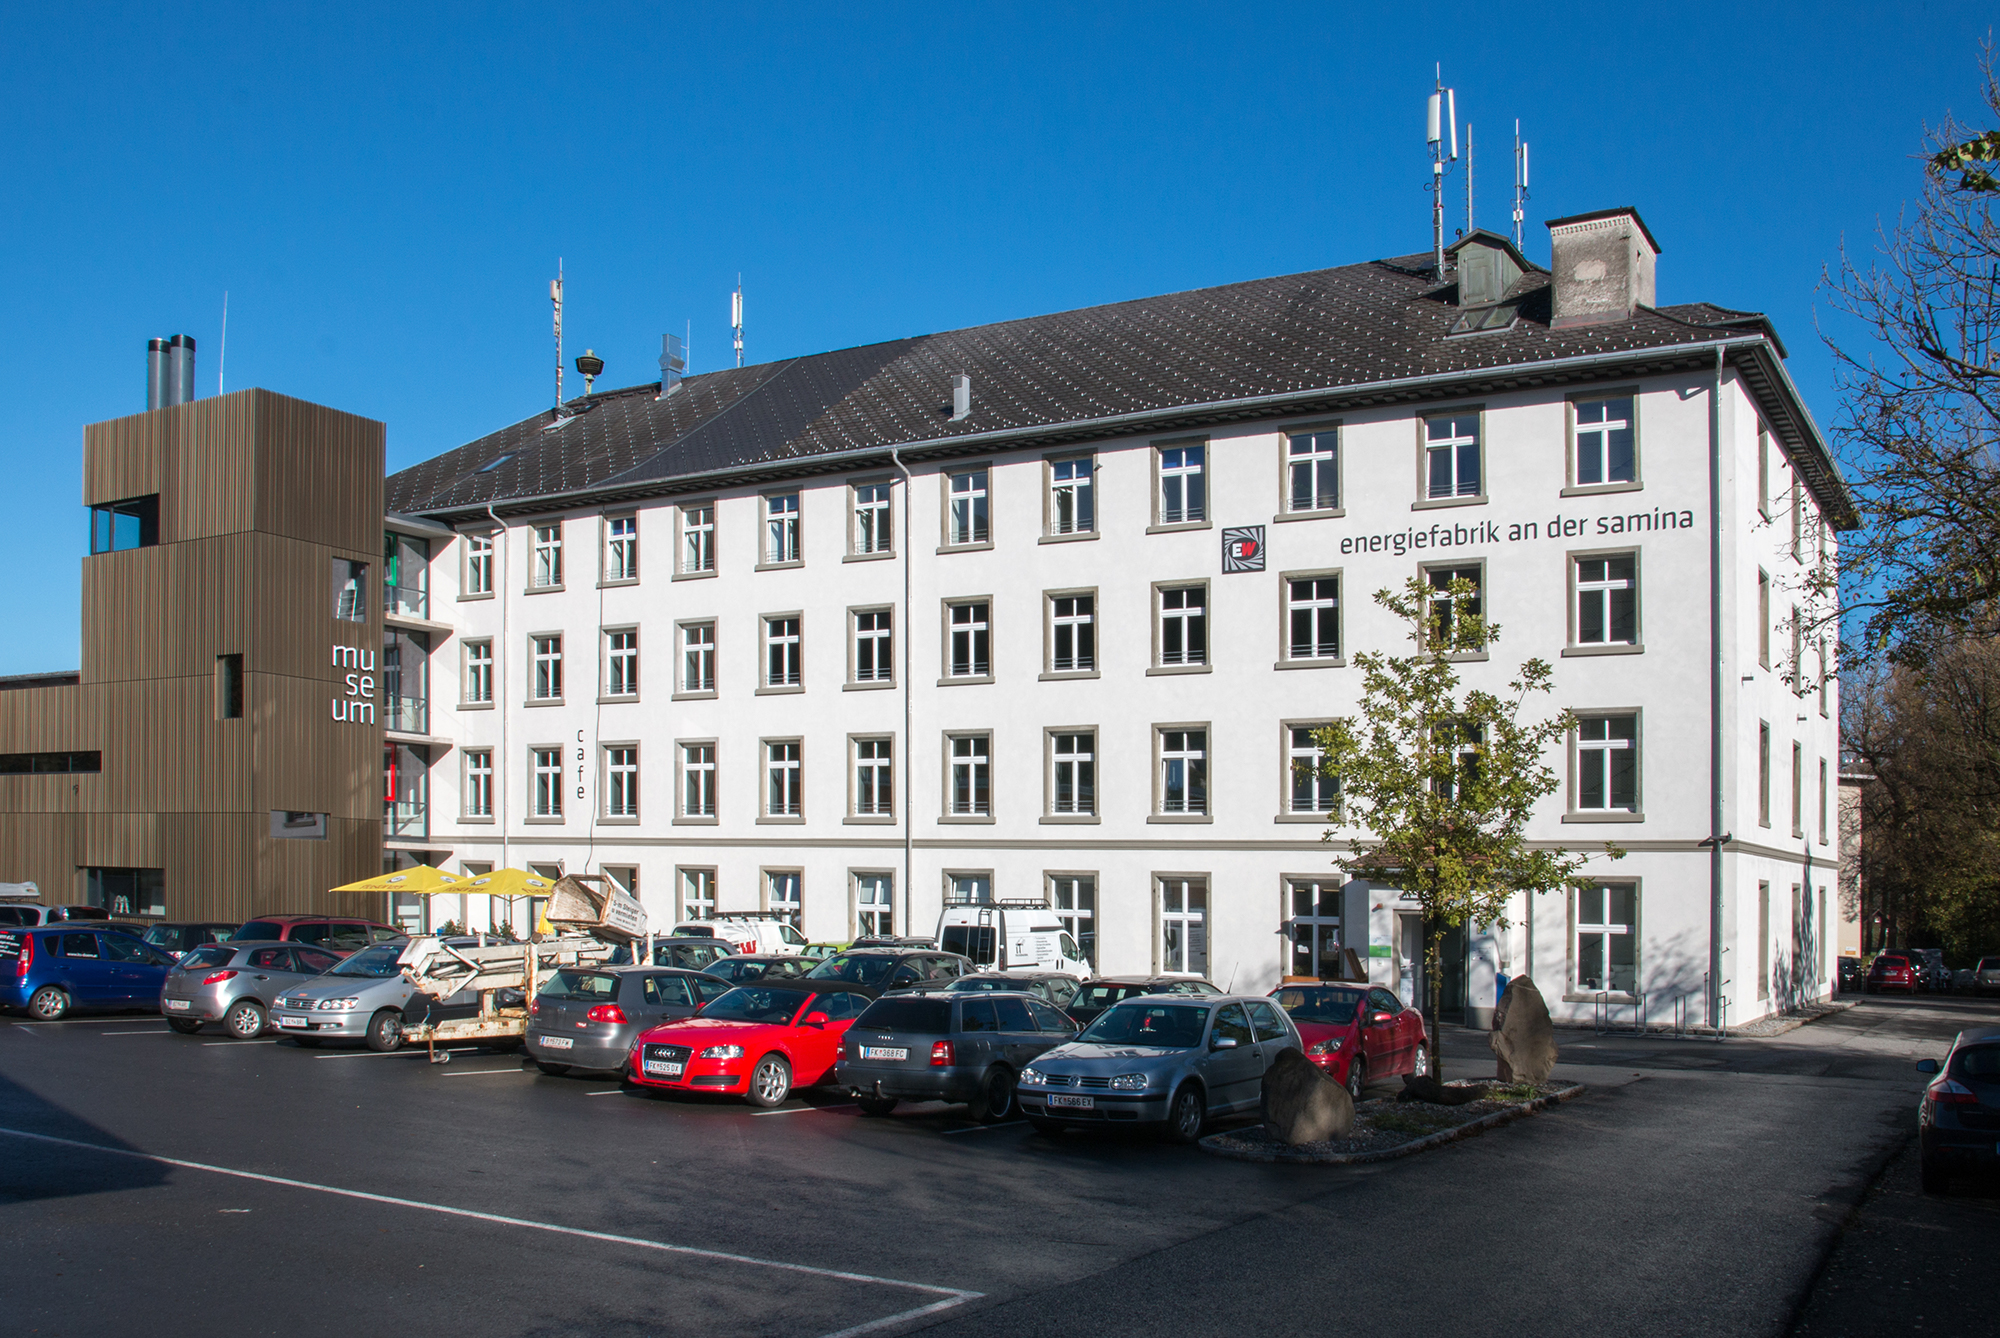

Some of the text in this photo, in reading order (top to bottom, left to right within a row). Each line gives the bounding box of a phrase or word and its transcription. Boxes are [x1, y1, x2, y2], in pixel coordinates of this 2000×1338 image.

[1340, 506, 1693, 556] energiefabrik an der samina
[1232, 541, 1257, 558] EW
[576, 729, 585, 799] cafe
[882, 1049, 895, 1057] 368
